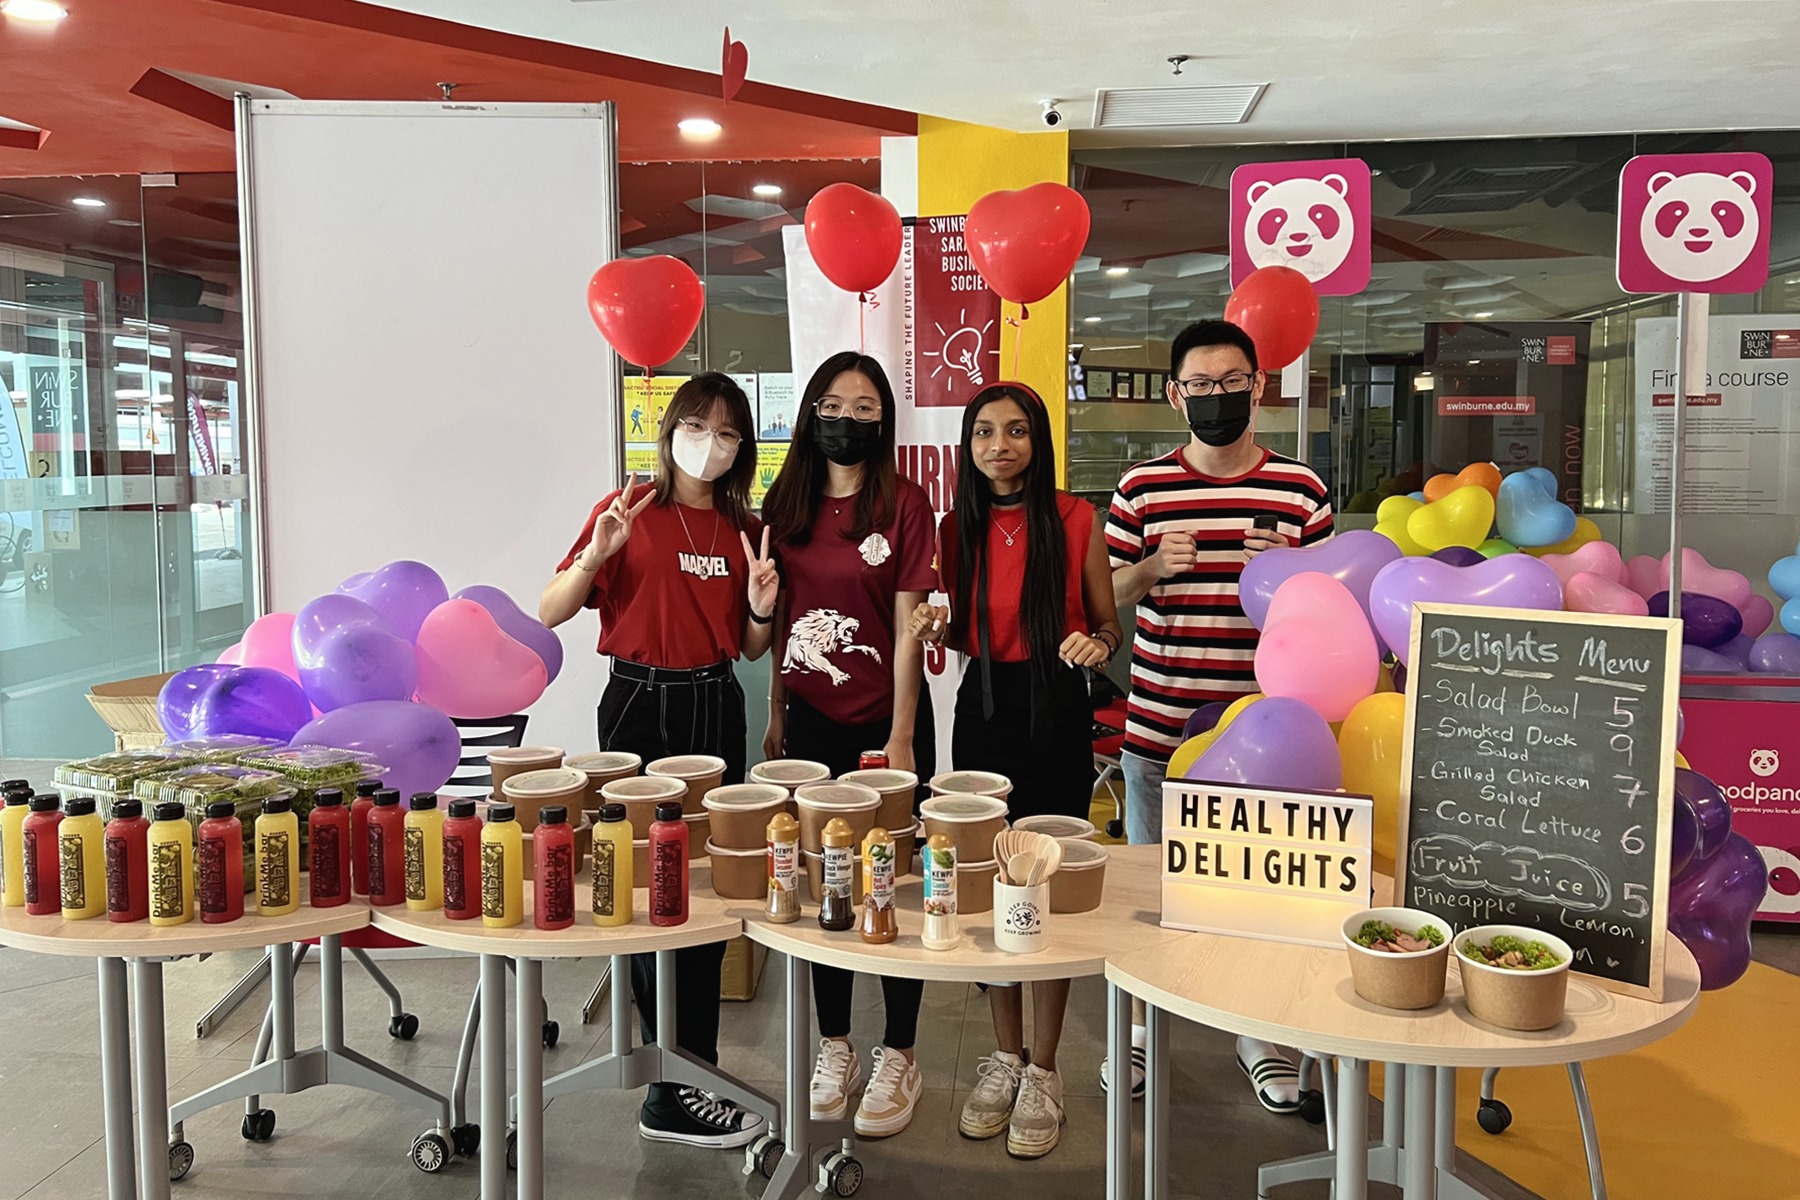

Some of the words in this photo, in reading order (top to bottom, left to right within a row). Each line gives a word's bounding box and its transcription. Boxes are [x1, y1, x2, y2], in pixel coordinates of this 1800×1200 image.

[929, 216, 968, 234] SWINB
[941, 236, 967, 253] SAR
[904, 226, 912, 270] LEADER
[904, 276, 912, 318] FUTURE
[904, 324, 912, 345] THE
[1524, 346, 1542, 355] BUR
[1747, 340, 1767, 349] BUR
[904, 350, 913, 400] SHAPING
[1652, 369, 1678, 388] Fin
[1718, 371, 1789, 387] course
[1446, 402, 1530, 413] swinburne.edu.my
[1565, 424, 1581, 474] now
[678, 552, 729, 576] MARVEL
[1431, 627, 1560, 676] Delights
[1579, 637, 1651, 676] Menu
[1521, 684, 1579, 719] Bowl
[1605, 697, 1640, 728] 5
[1477, 740, 1528, 762] Salad
[1526, 725, 1577, 747] Duck
[1610, 733, 1634, 767] 9
[1480, 785, 1541, 808] Salad
[1507, 768, 1590, 791] Chicken
[1613, 773, 1649, 808] 7
[1181, 793, 1354, 843] HEALTHY
[1521, 809, 1602, 843] Lettuce
[1620, 825, 1645, 855] 6
[152, 841, 161, 918] DrinkMe.bar
[260, 832, 269, 907] DrinkMe.bar
[545, 846, 556, 922] DrinkMe.bar
[654, 841, 664, 916] DrinkMe.bar
[1168, 839, 1357, 892] DELIGHTS
[1419, 846, 1482, 876] Fruit
[1509, 858, 1583, 896] Juice
[1622, 882, 1650, 919] 5
